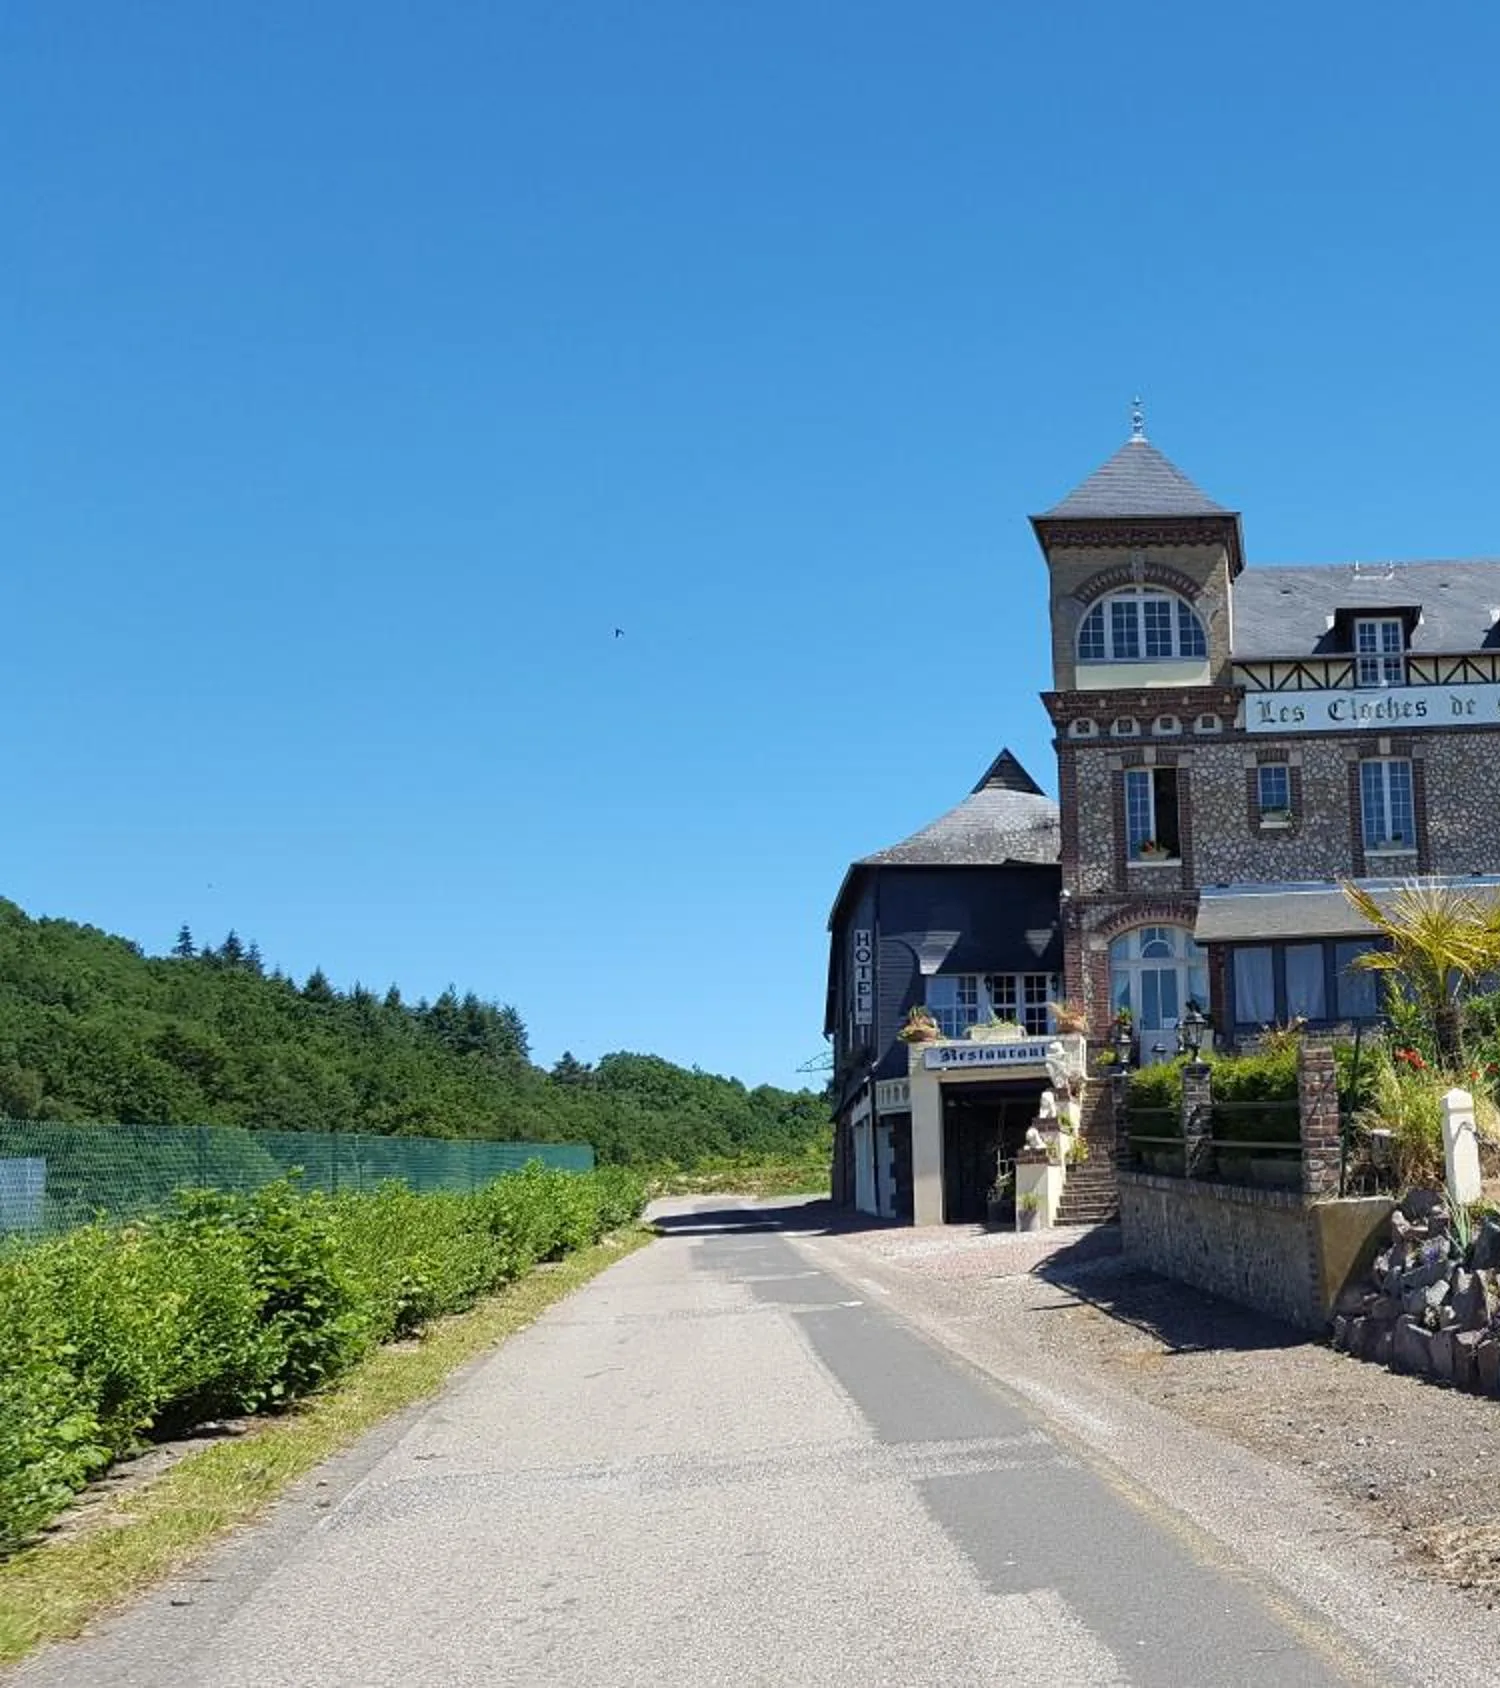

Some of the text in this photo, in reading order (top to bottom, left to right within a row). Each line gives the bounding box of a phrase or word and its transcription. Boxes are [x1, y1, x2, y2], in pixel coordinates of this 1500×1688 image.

[1256, 698, 1305, 724] Les
[1327, 696, 1428, 723] Cloches
[1449, 694, 1476, 716] de
[855, 931, 871, 1012] HOTEL
[938, 1046, 1046, 1063] Restaurant
